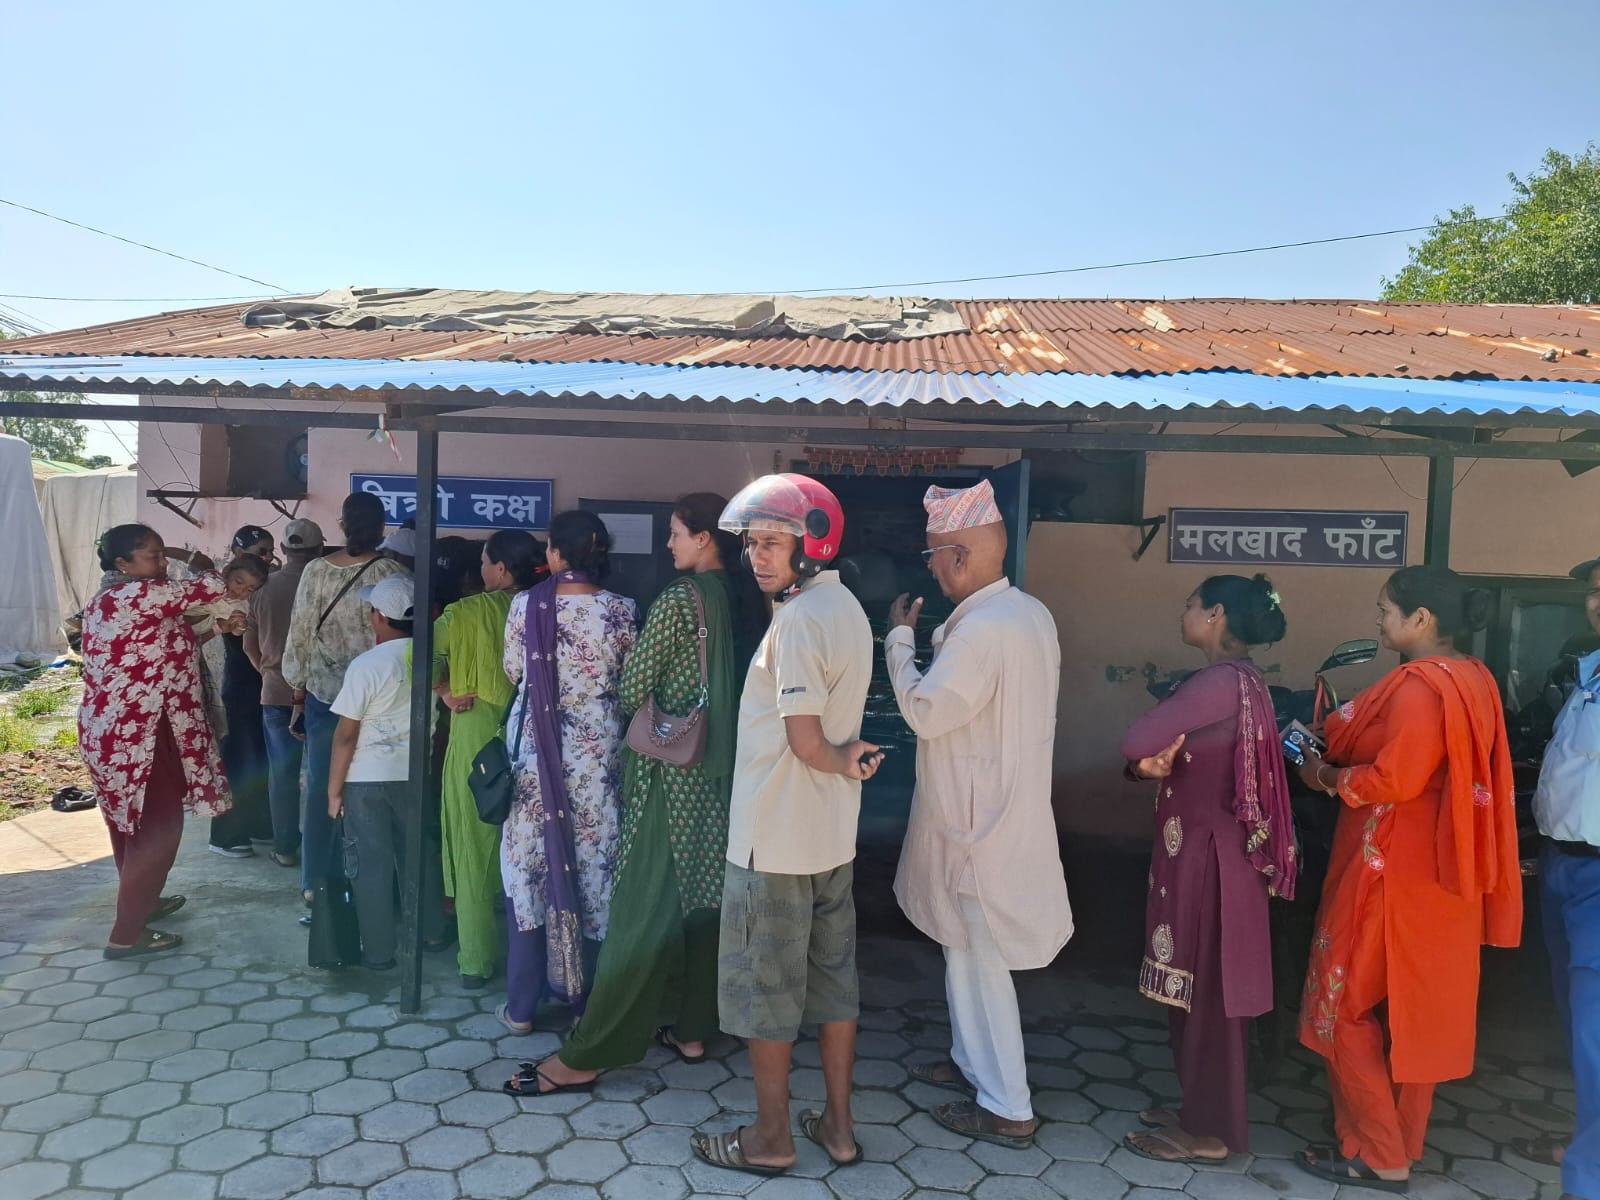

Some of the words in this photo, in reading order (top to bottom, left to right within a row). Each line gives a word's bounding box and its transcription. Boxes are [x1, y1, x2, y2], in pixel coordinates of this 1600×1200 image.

[470, 493, 542, 524] कक्ष
[1176, 524, 1308, 559] मलखाद
[1323, 517, 1402, 561] फाँट
